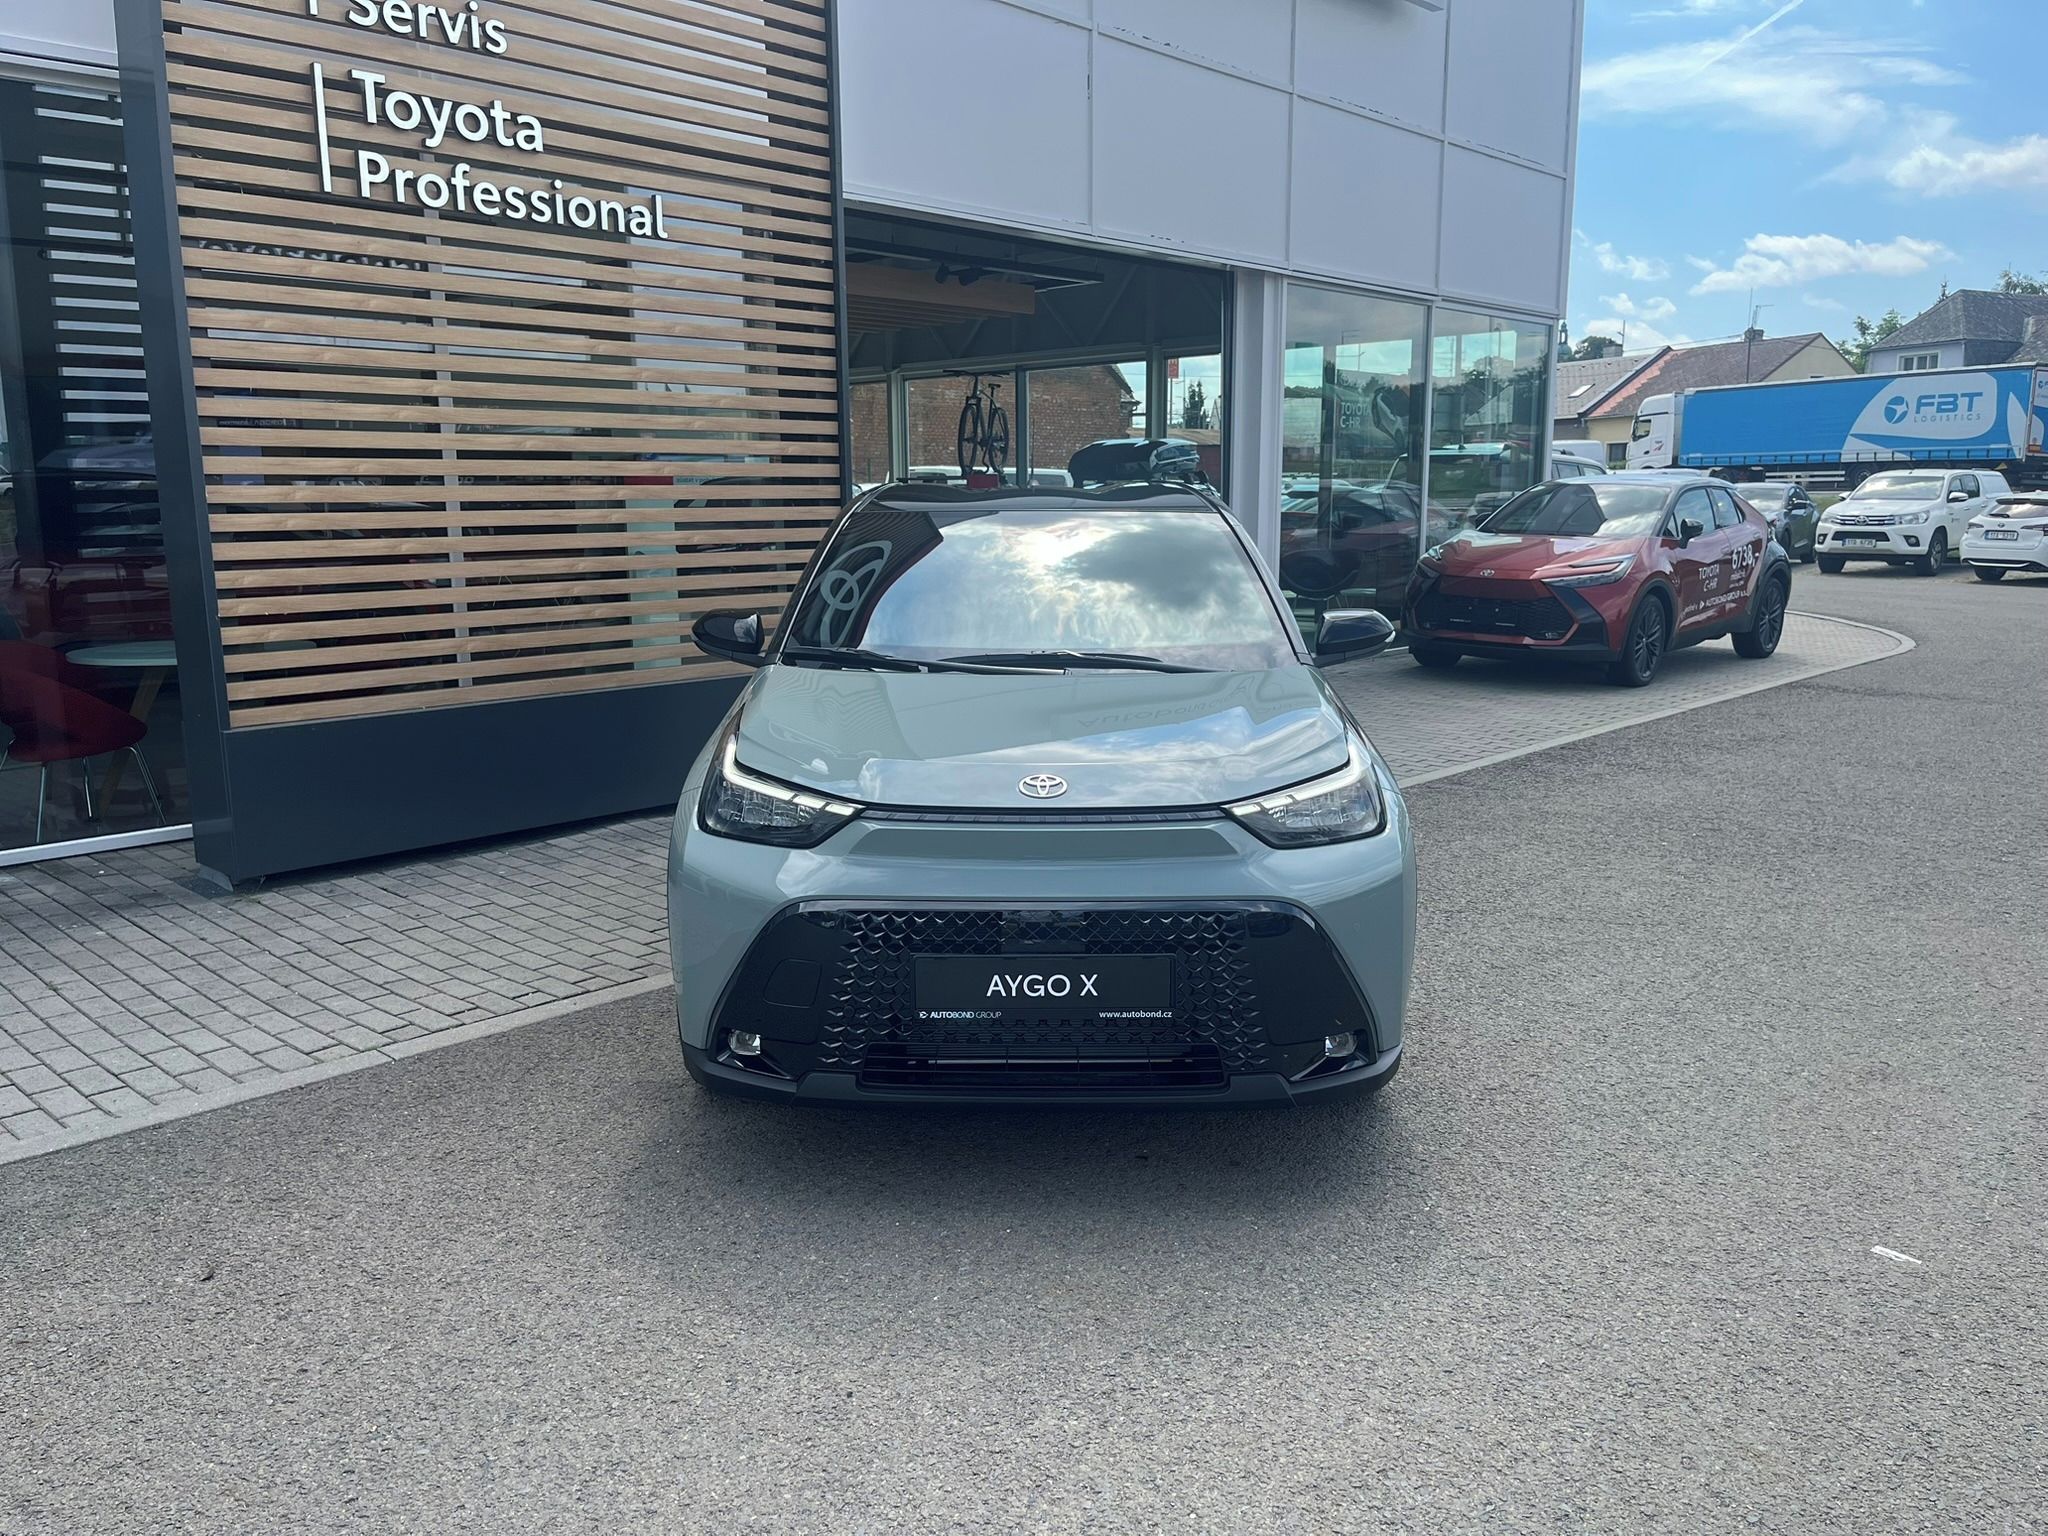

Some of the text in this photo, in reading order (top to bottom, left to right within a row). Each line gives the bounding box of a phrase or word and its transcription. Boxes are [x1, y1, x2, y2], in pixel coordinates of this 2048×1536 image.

[347, 0, 508, 54] Servis
[349, 69, 544, 152] Toyota
[356, 150, 669, 239] Professional
[1341, 402, 1370, 416] TOYOTA
[1915, 392, 1983, 415] FBT
[1914, 413, 1982, 423] LOGISTICS
[986, 974, 1099, 997] AYGO X
[929, 1011, 1002, 1019] AUTOBOND GROUP
[1099, 1010, 1173, 1018] www.autobond.cz
